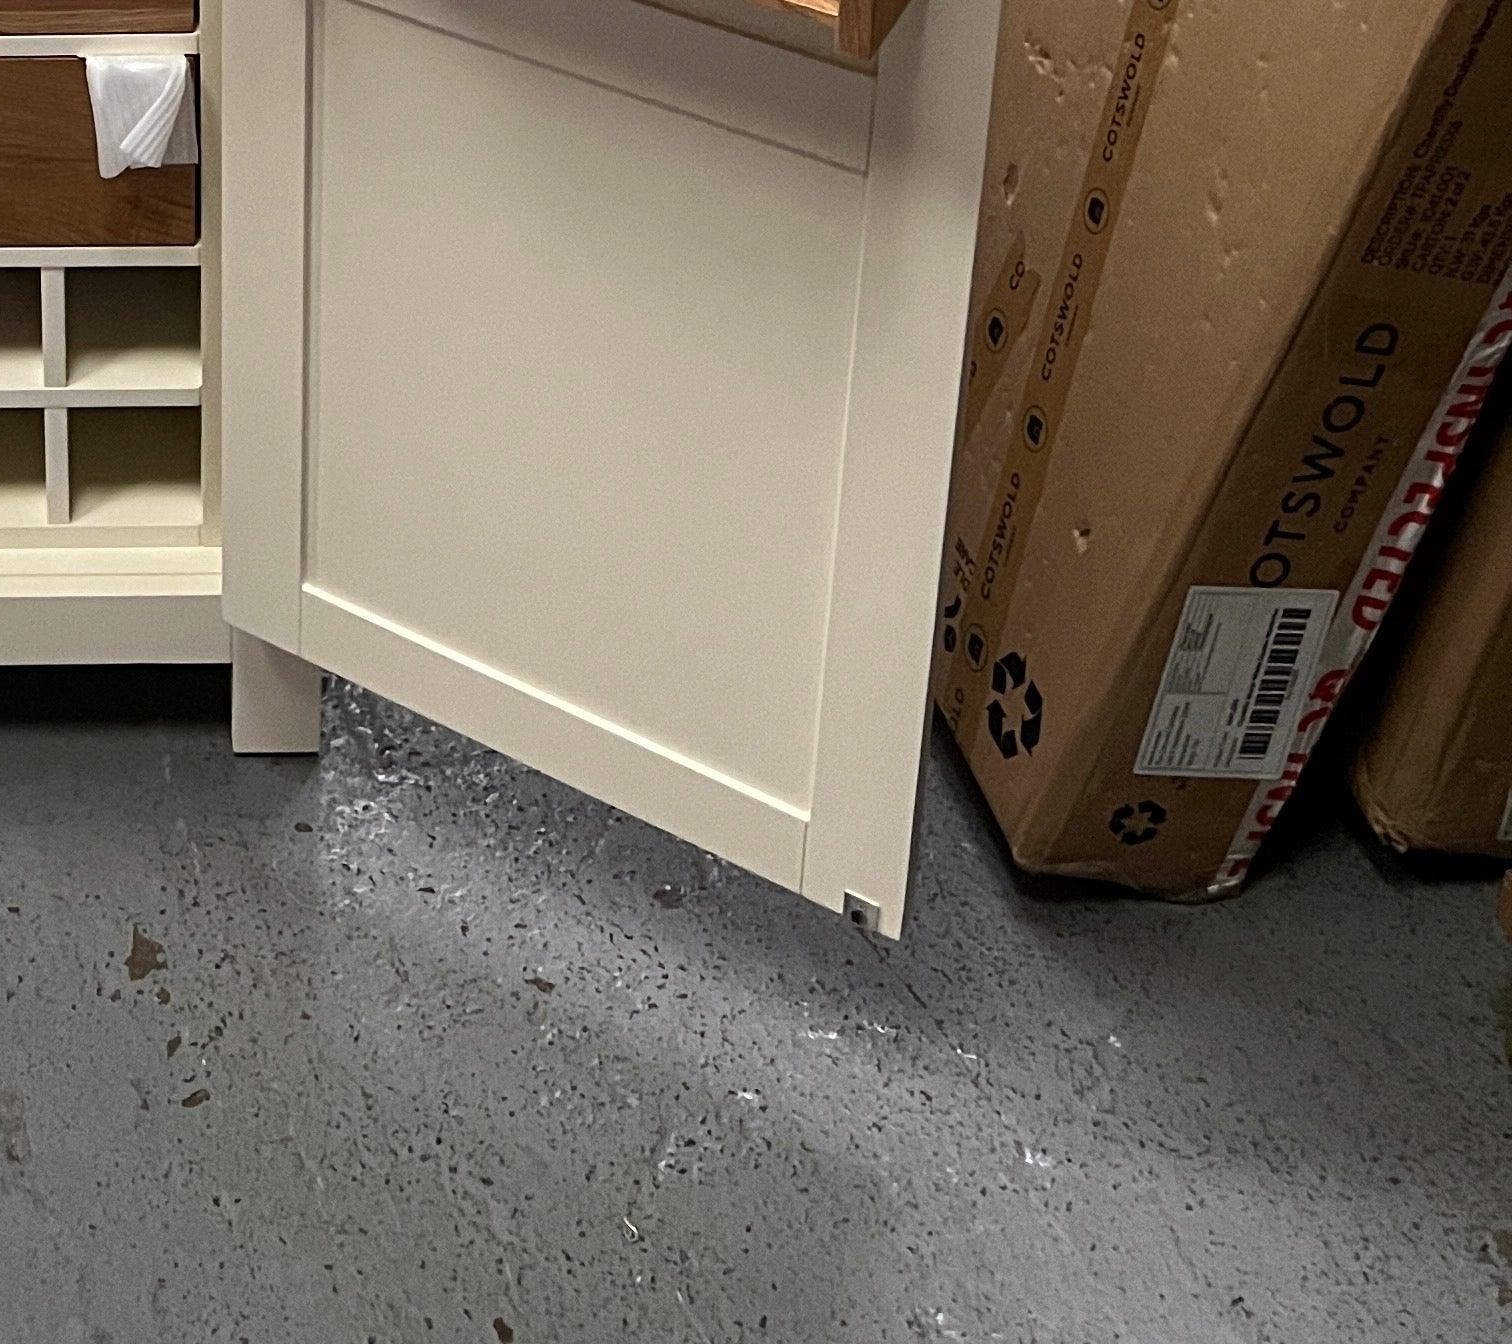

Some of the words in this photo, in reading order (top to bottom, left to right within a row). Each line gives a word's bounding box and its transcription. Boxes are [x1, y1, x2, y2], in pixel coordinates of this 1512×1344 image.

[1102, 32, 1146, 162] COTSWOLD
[1041, 253, 1083, 381] COTSWOLD
[981, 472, 1021, 600] COTSWOLD
[1332, 436, 1390, 534] COMPANY
